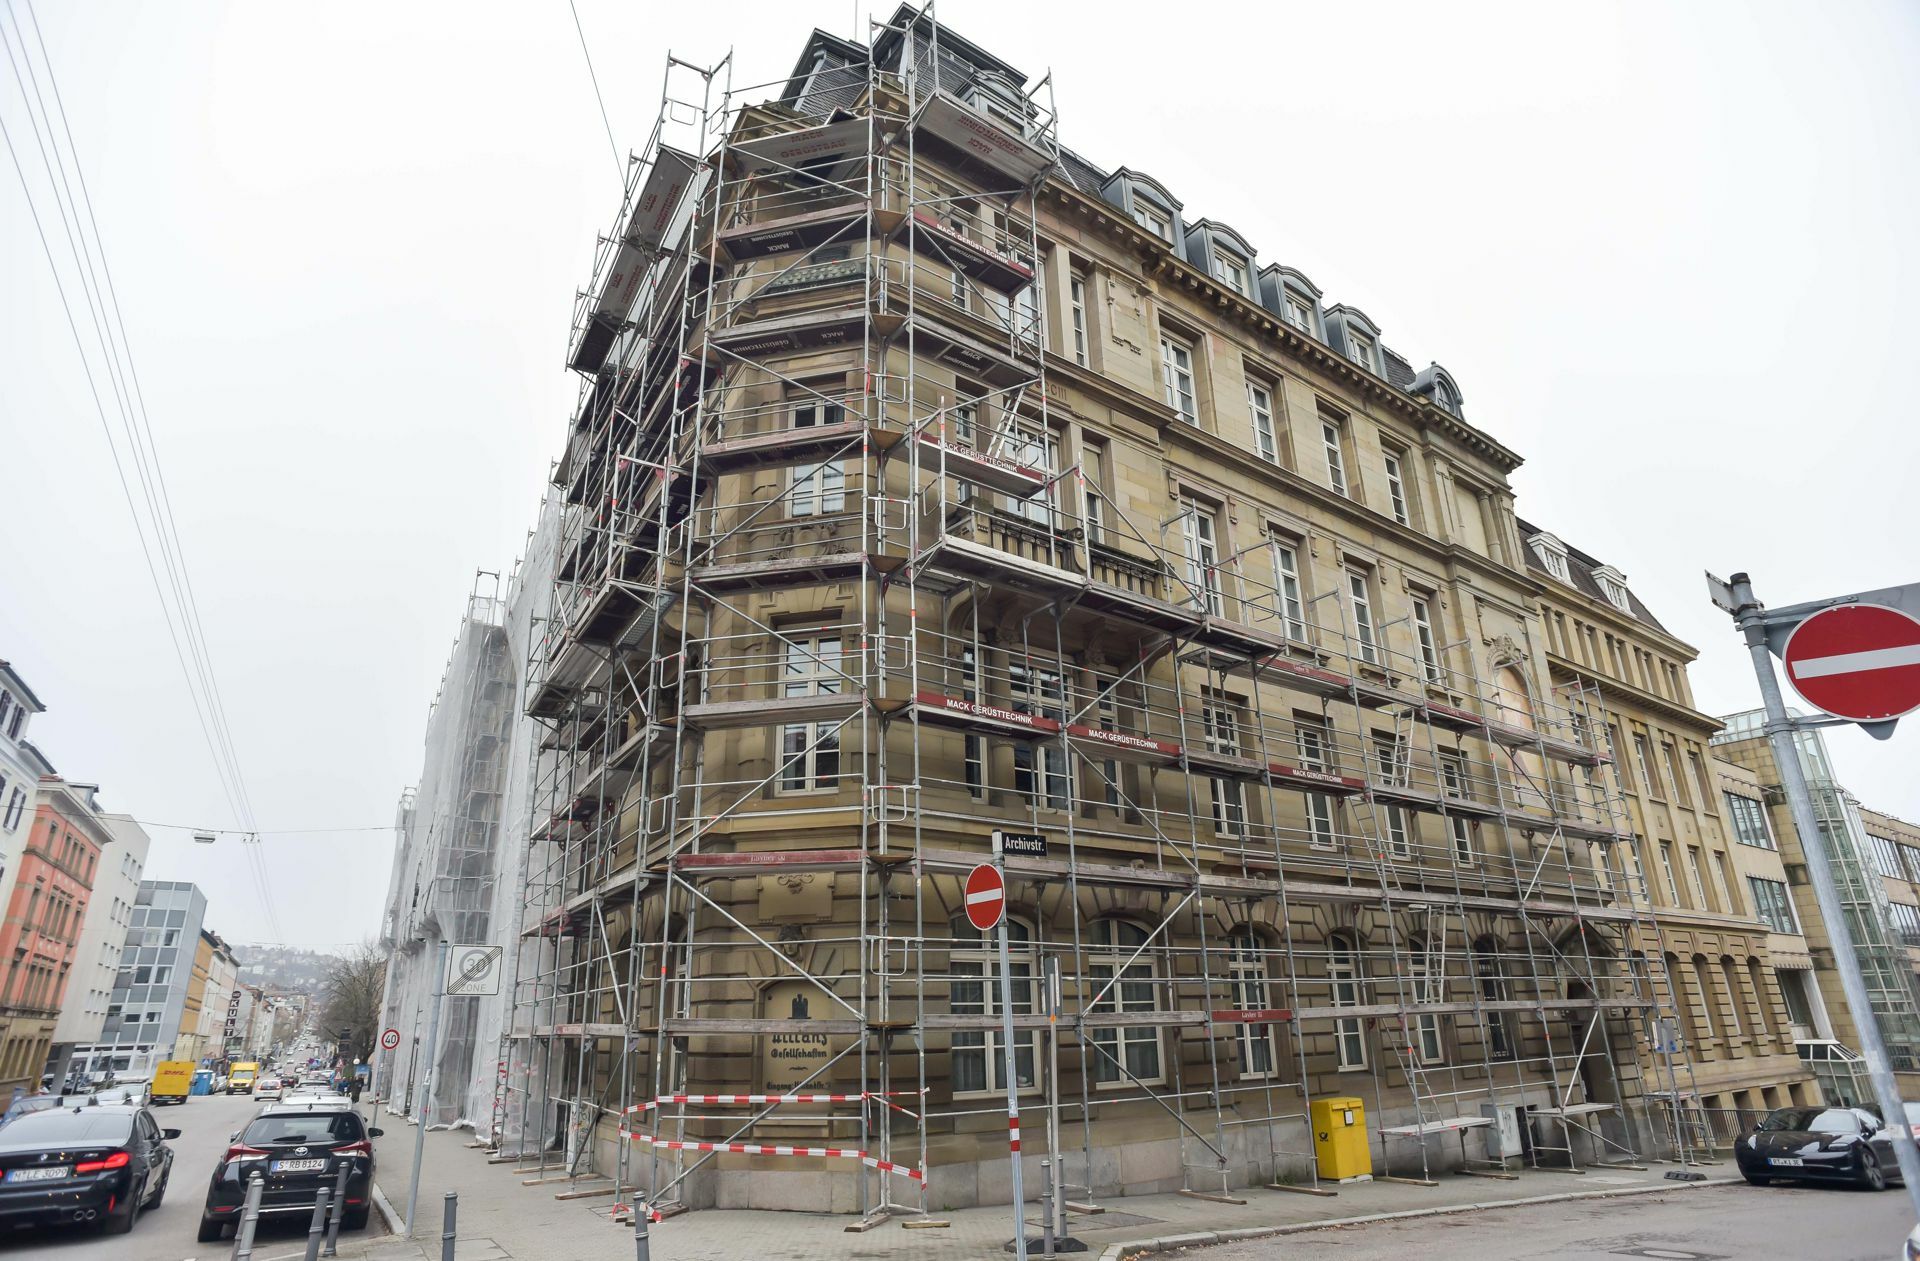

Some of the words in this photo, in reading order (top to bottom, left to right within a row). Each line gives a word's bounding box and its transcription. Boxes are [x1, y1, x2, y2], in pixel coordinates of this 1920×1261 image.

[936, 223, 957, 237] MACK
[957, 235, 1009, 265] GERÜSTTECHNIK
[960, 447, 1018, 473] GERÜSTTECHNIK
[946, 699, 969, 712] MACK
[1088, 729, 1107, 740] MACK
[1108, 733, 1158, 750] GERÜSTTECHNIK
[1292, 768, 1306, 778] MACK
[1005, 836, 1045, 852] Archivstr.
[461, 983, 487, 993] ZONE
[227, 1000, 238, 1036] KULT
[385, 1035, 397, 1044] 40
[289, 1160, 301, 1169] RB
[302, 1160, 323, 1169] 8124
